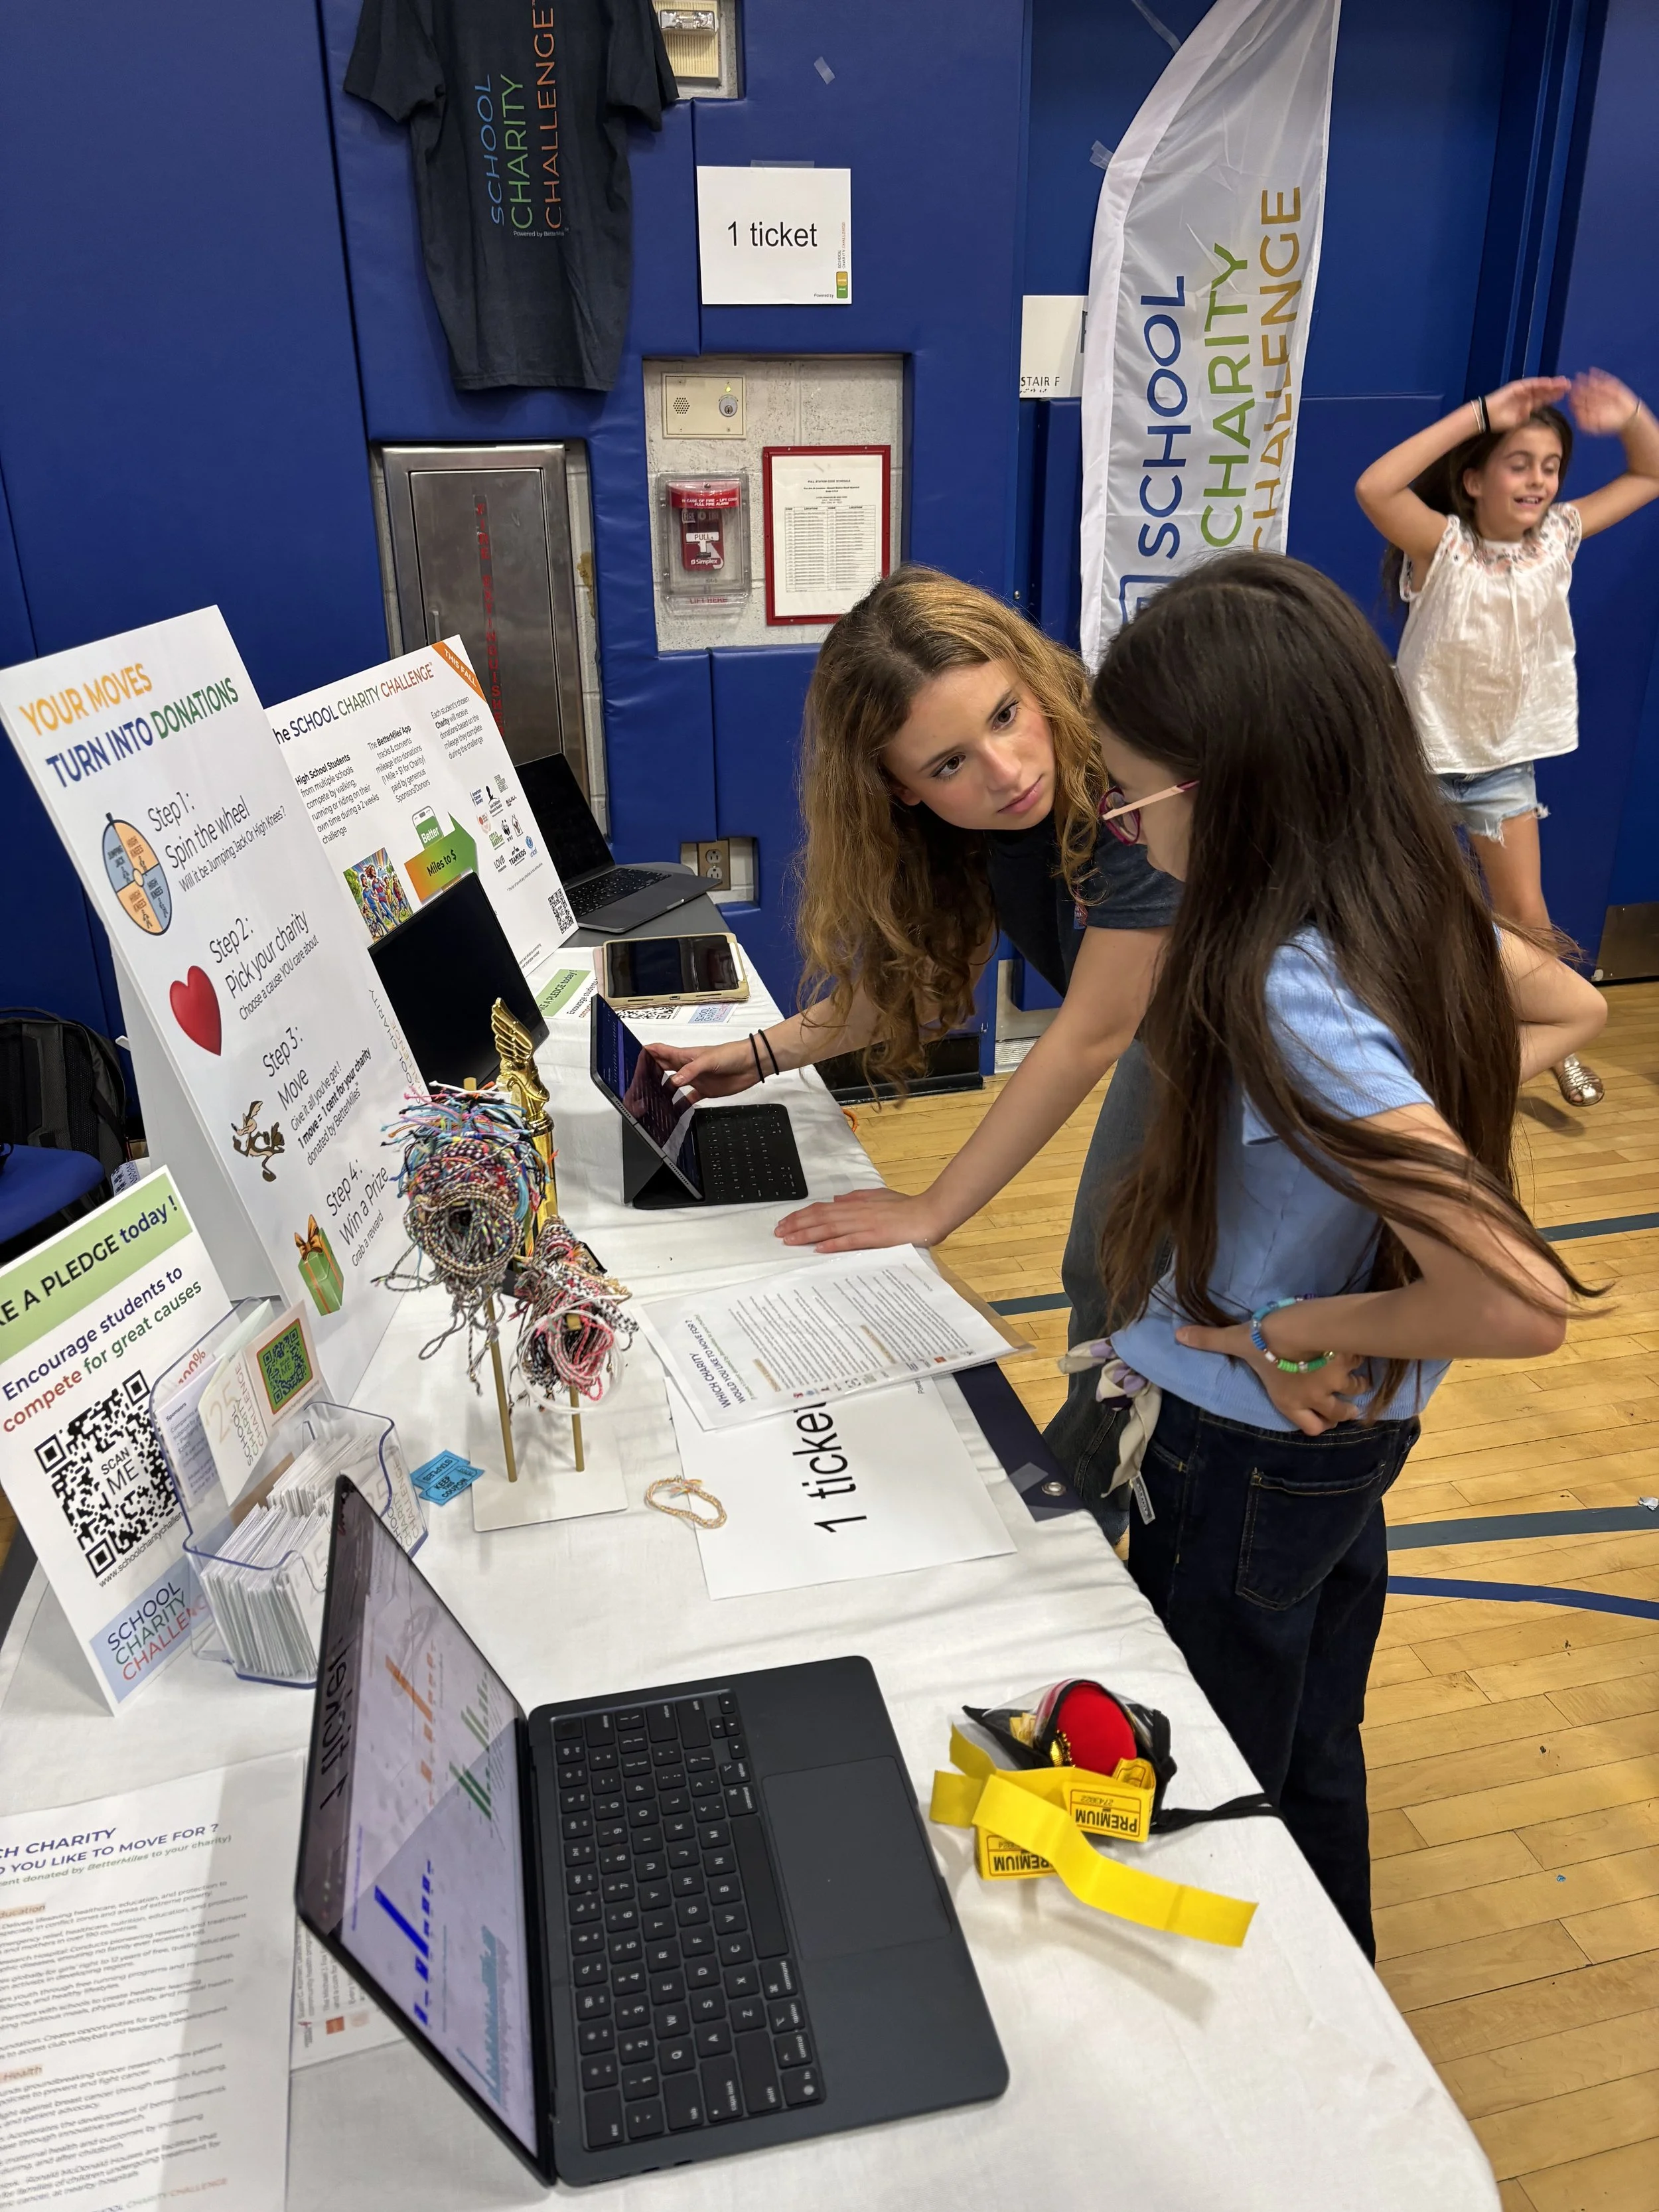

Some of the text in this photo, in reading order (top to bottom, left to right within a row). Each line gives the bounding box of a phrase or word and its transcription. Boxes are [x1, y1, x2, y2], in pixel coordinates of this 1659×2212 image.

[533, 7, 561, 229] CHALLENGE
[474, 74, 504, 226] SCHOOL
[500, 74, 533, 229] CHARITY
[727, 221, 738, 246] 1
[750, 221, 818, 248] ticket
[1021, 376, 1060, 386] STAIR F
[1200, 243, 1254, 548] CHARITY
[1137, 275, 1192, 559] SCHOOL
[444, 648, 477, 687] THIS FALL
[19, 663, 153, 736] YOUR MOVES
[272, 663, 434, 745] he SCHOOL CHARITY CHALLENGE
[45, 677, 239, 788] TURN INTO DONATIONS
[295, 754, 351, 786] High School Students
[300, 765, 354, 798] from multiple schools
[306, 778, 358, 810] compete by walking,
[311, 784, 372, 822] running or riding on their
[317, 793, 380, 833] own time during weeks
[147, 801, 181, 832] Step
[165, 795, 250, 870] Spin the wheel
[322, 825, 348, 845] challenge
[420, 826, 439, 844] Better
[179, 874, 195, 892] Will
[198, 865, 210, 879] be
[206, 844, 236, 872] Jumping
[232, 834, 248, 853] Jack
[246, 830, 255, 843] Or
[252, 820, 268, 838] High
[265, 811, 283, 830] Knees
[425, 848, 458, 877] Miles to $
[494, 854, 506, 869] LOVB
[210, 929, 240, 963] Step
[224, 911, 309, 999] Pick your charity
[239, 934, 319, 1020] Choose cause YOU care about
[548, 984, 564, 1001] PLEDGE
[368, 989, 397, 1050] CHARITY
[262, 1041, 291, 1077] Step
[277, 1069, 309, 1111] Move
[291, 1112, 305, 1131] Give
[308, 1093, 317, 1110] all
[328, 1068, 340, 1085] got
[302, 1047, 372, 1146] move cent for your charity
[307, 1128, 331, 1166] donated
[329, 1123, 337, 1140] by
[326, 1177, 351, 1217] Step
[338, 1167, 389, 1246] Win a Prize
[22, 1195, 178, 1311] A PLEDGE today !
[352, 1209, 384, 1267] Grab reward
[2, 1266, 183, 1401] Encourage students to
[3, 1280, 202, 1433] compete for great causes
[100, 1445, 131, 1477] SCAN
[106, 1459, 141, 1497] ME
[423, 1459, 453, 1481] STAPLES
[434, 1476, 450, 1490] KEEP
[441, 1477, 469, 1498] COUPON
[814, 1514, 868, 1533] 1
[108, 1582, 181, 1652] SCHOOL
[115, 1589, 185, 1666] CHARITY
[26, 1827, 117, 1854] CHARITY
[1075, 1808, 1138, 1834] PREMIUM
[11, 1826, 206, 1873] YOU LIKE TO MOVE FOR
[993, 1855, 1050, 1872] REMIUM
